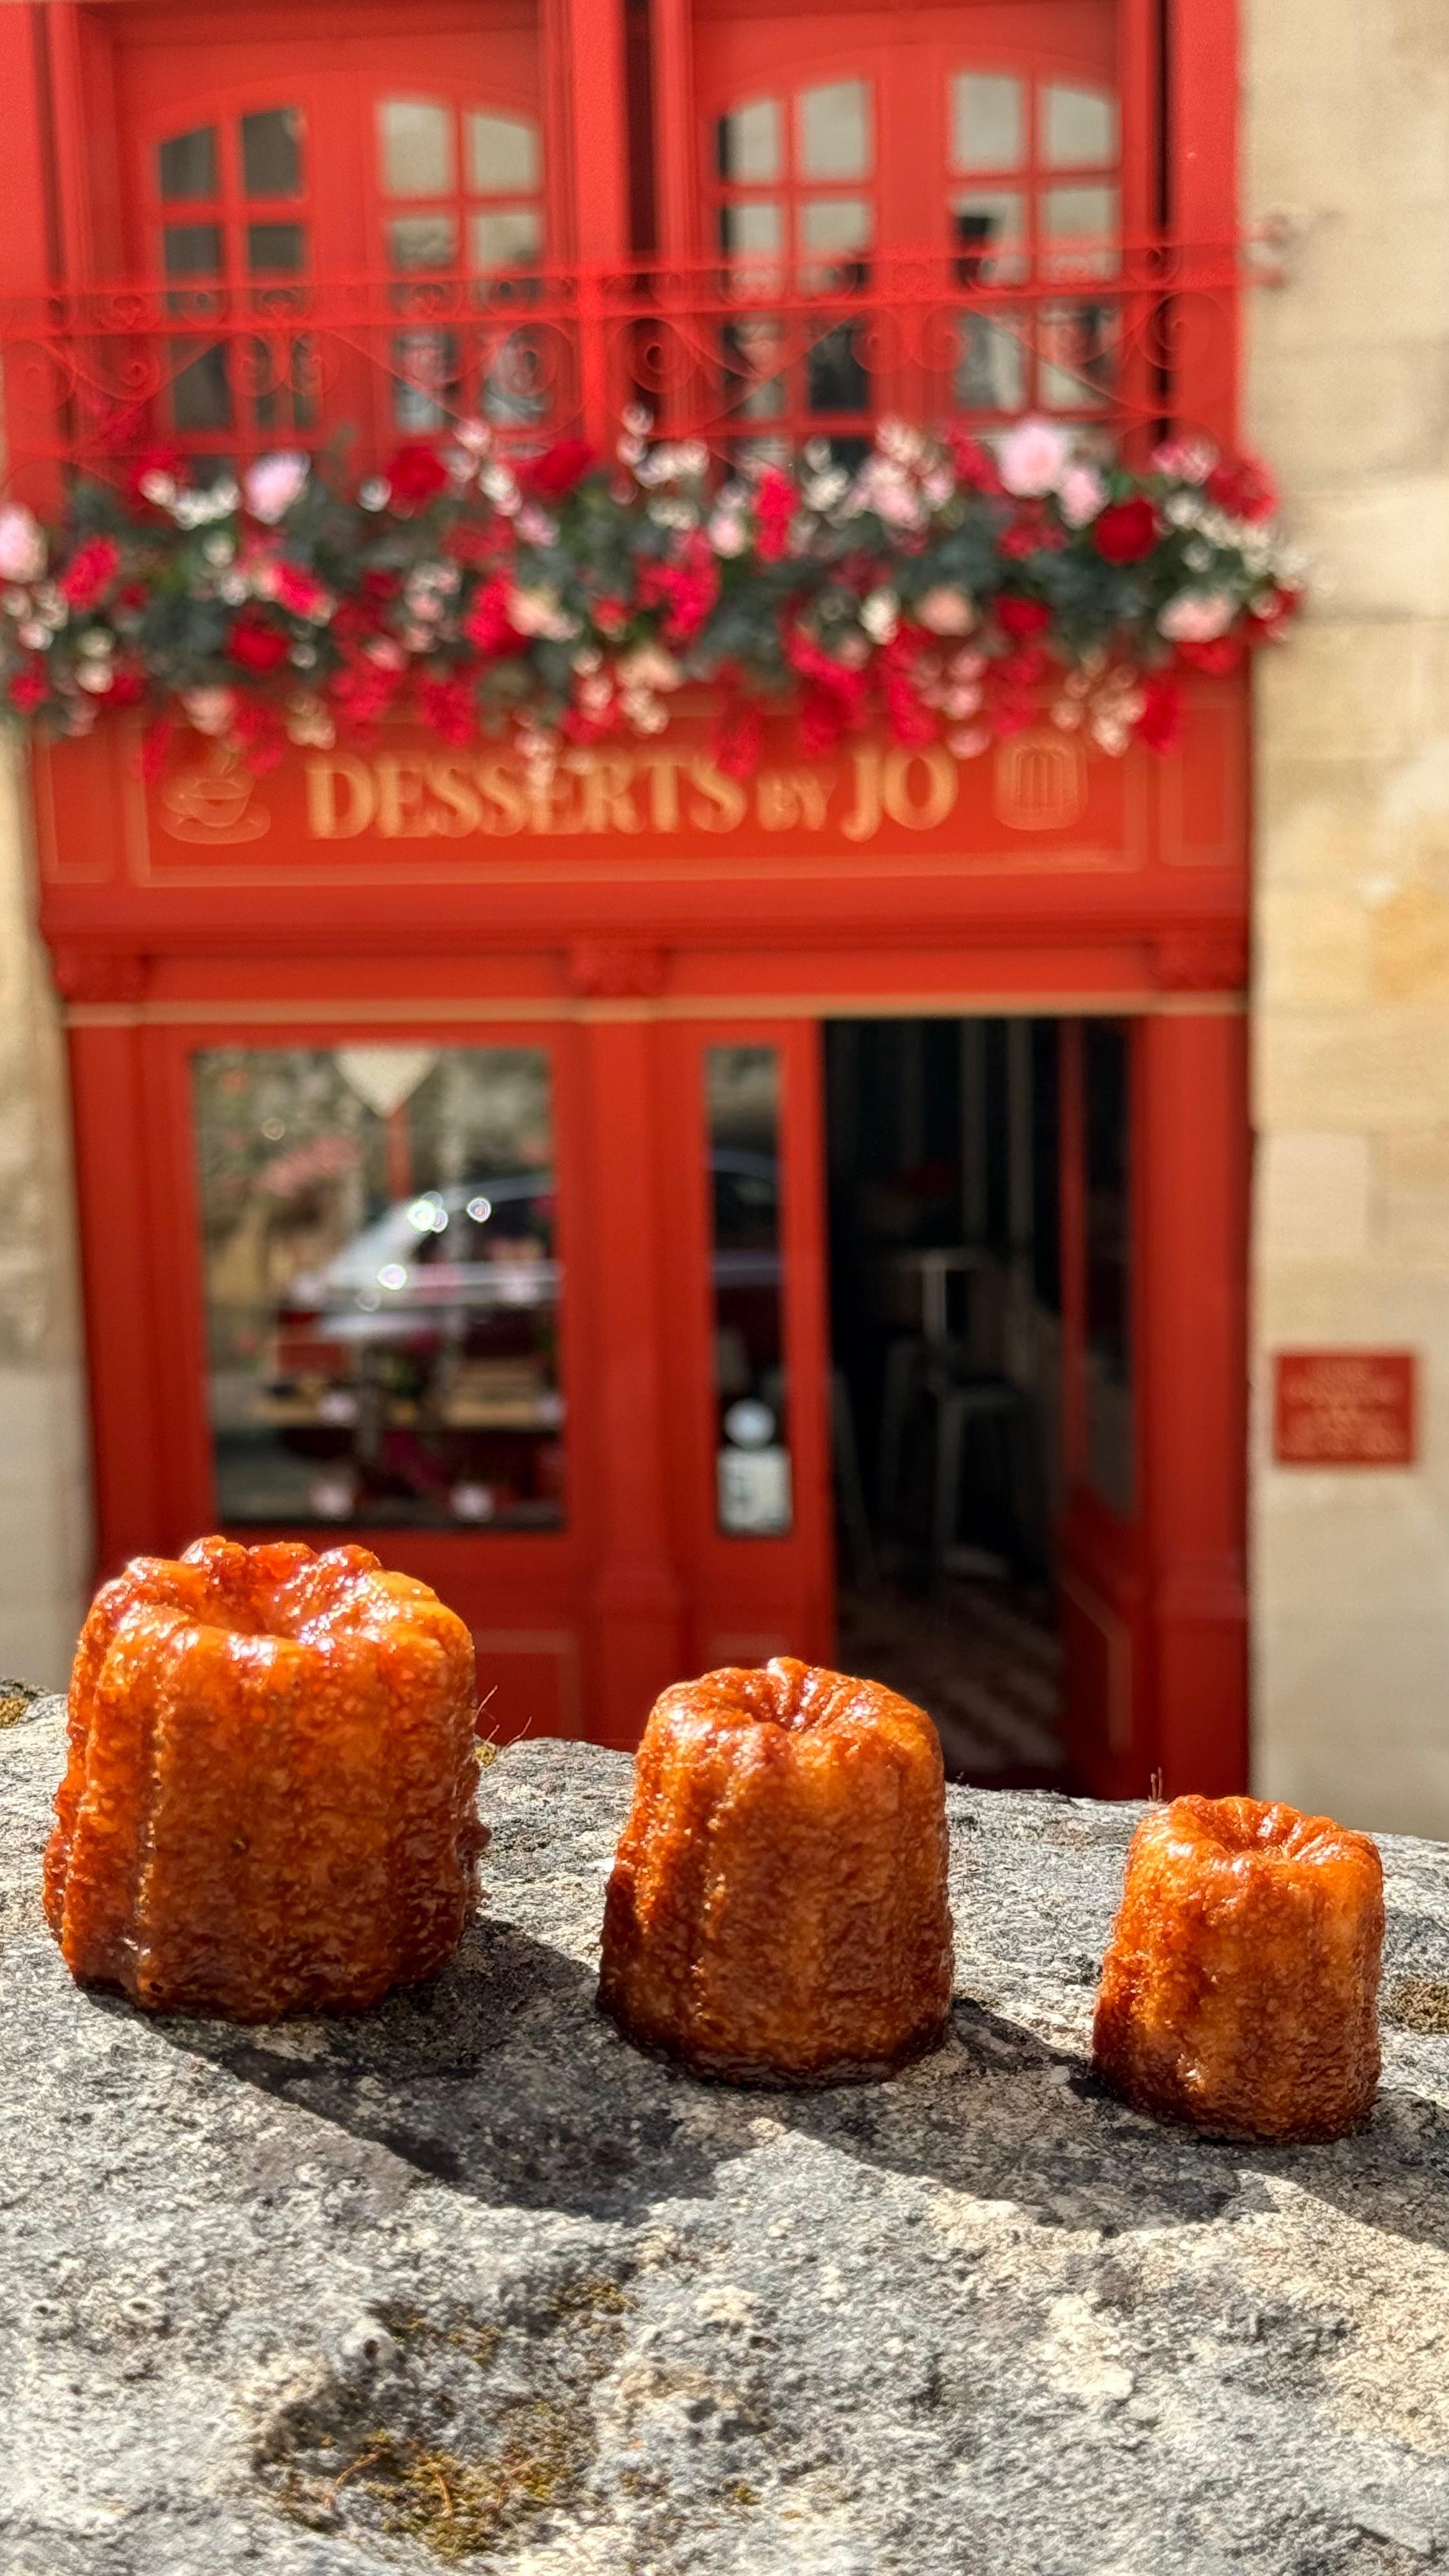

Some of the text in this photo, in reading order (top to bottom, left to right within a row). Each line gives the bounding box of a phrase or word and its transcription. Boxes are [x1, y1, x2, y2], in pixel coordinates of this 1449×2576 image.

[305, 744, 958, 842] DESSERTS BY JO
